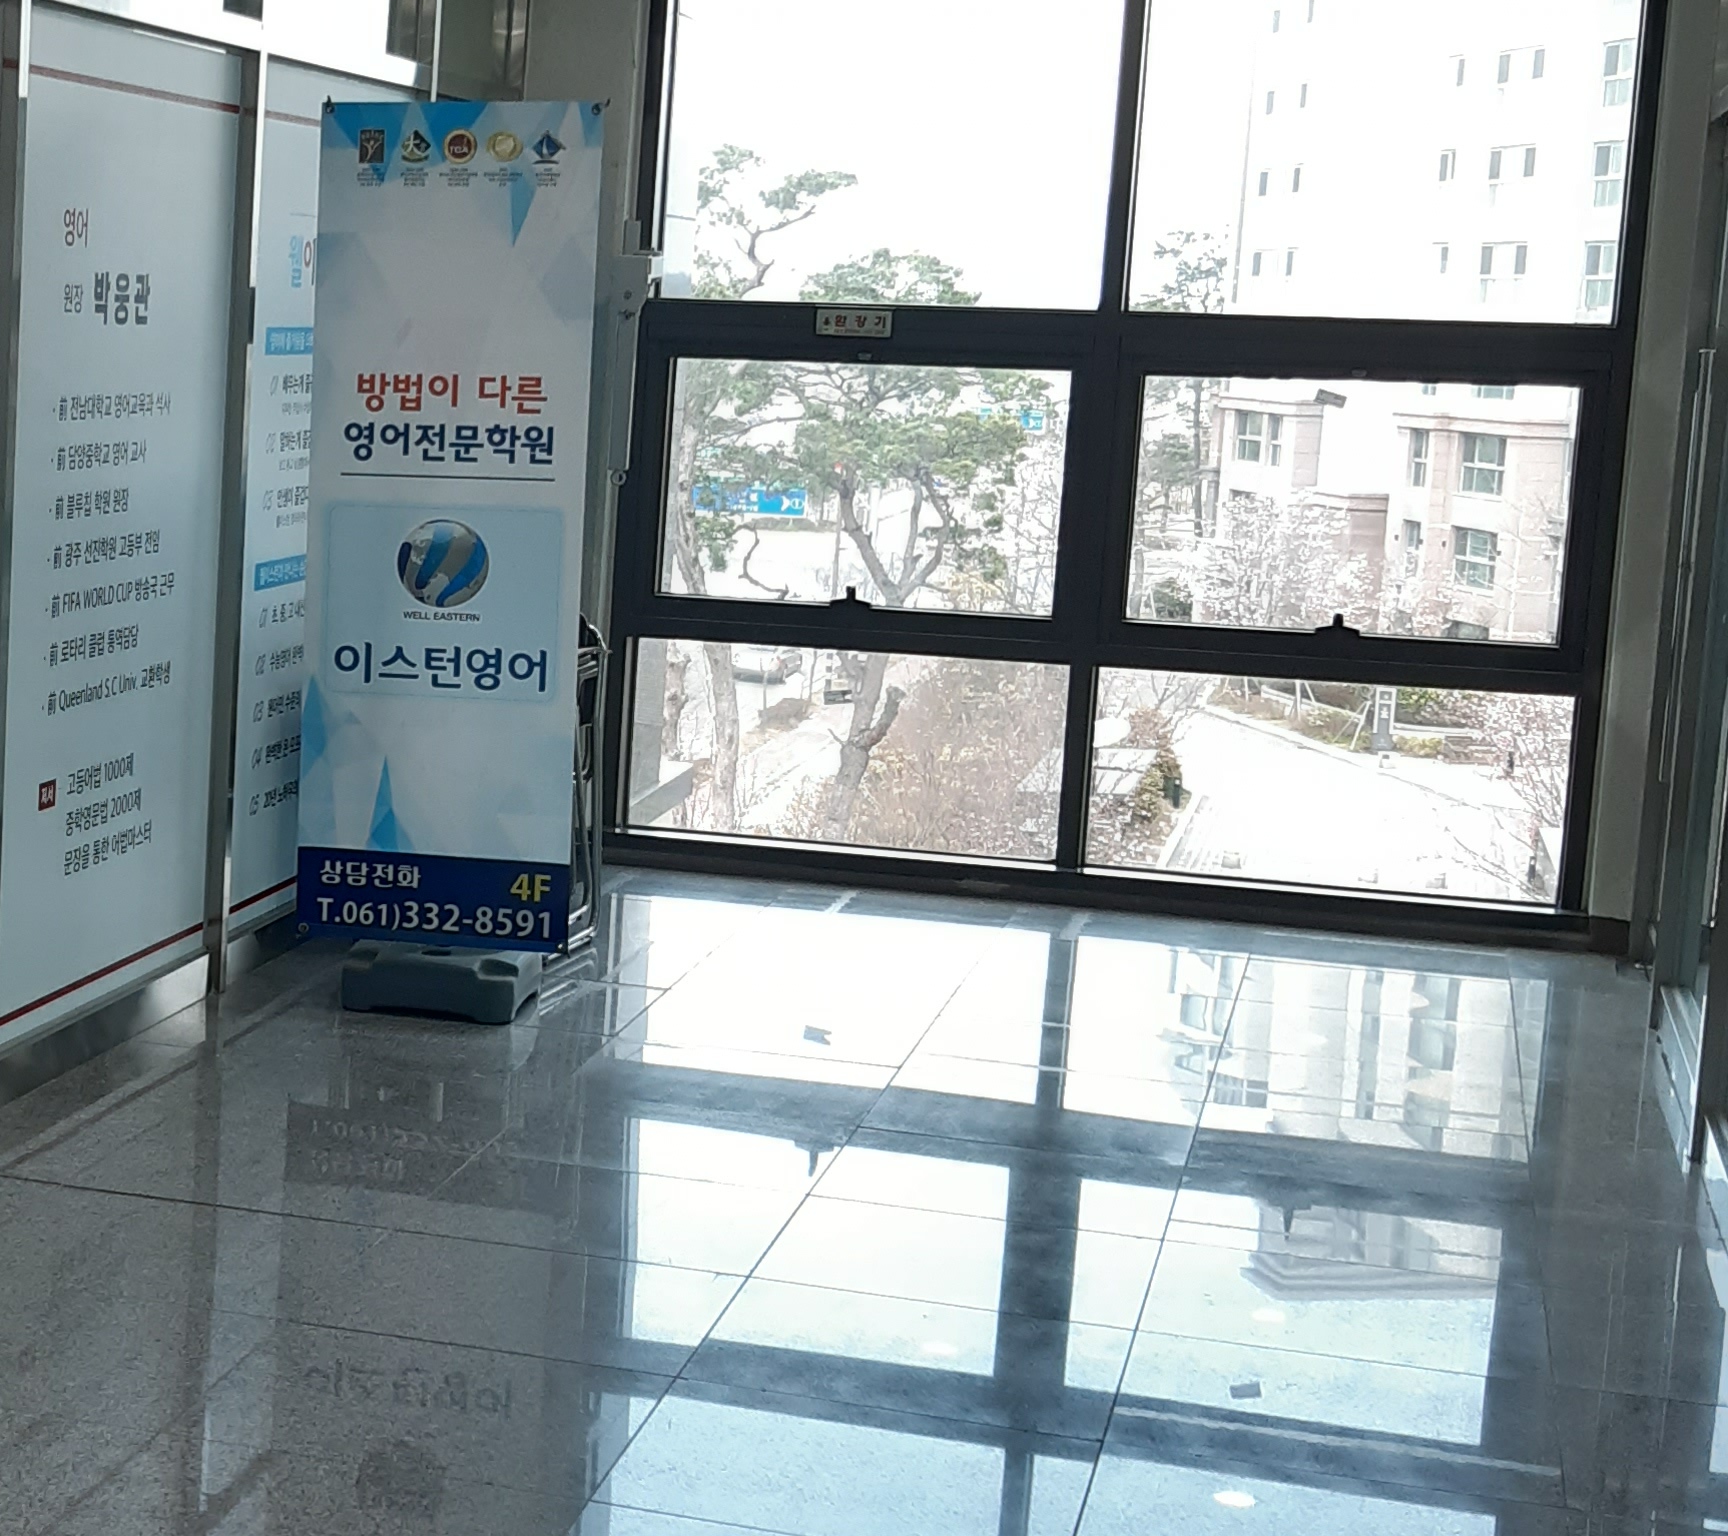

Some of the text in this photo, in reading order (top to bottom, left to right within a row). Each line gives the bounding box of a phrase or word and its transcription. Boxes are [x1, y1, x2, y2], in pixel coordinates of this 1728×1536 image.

[63, 207, 88, 248] 영어
[63, 271, 150, 325] 원장 박웅관
[70, 394, 112, 420] 전남대학교
[114, 392, 153, 419] 영어교육과
[357, 372, 459, 413] 방법이
[478, 375, 548, 414] 다른
[112, 441, 128, 466] 영어
[130, 439, 147, 464] 교사
[343, 421, 555, 464] 영어전문학원
[94, 487, 129, 515] 학원 원장
[65, 542, 82, 568] 광주
[62, 580, 133, 614] FIFA WORLD CUP
[403, 610, 481, 623] WELL EASTERN
[334, 642, 548, 693] 이스턴영어
[319, 860, 552, 903] 상담전화 4F
[317, 897, 552, 939] T.061)332-8591
